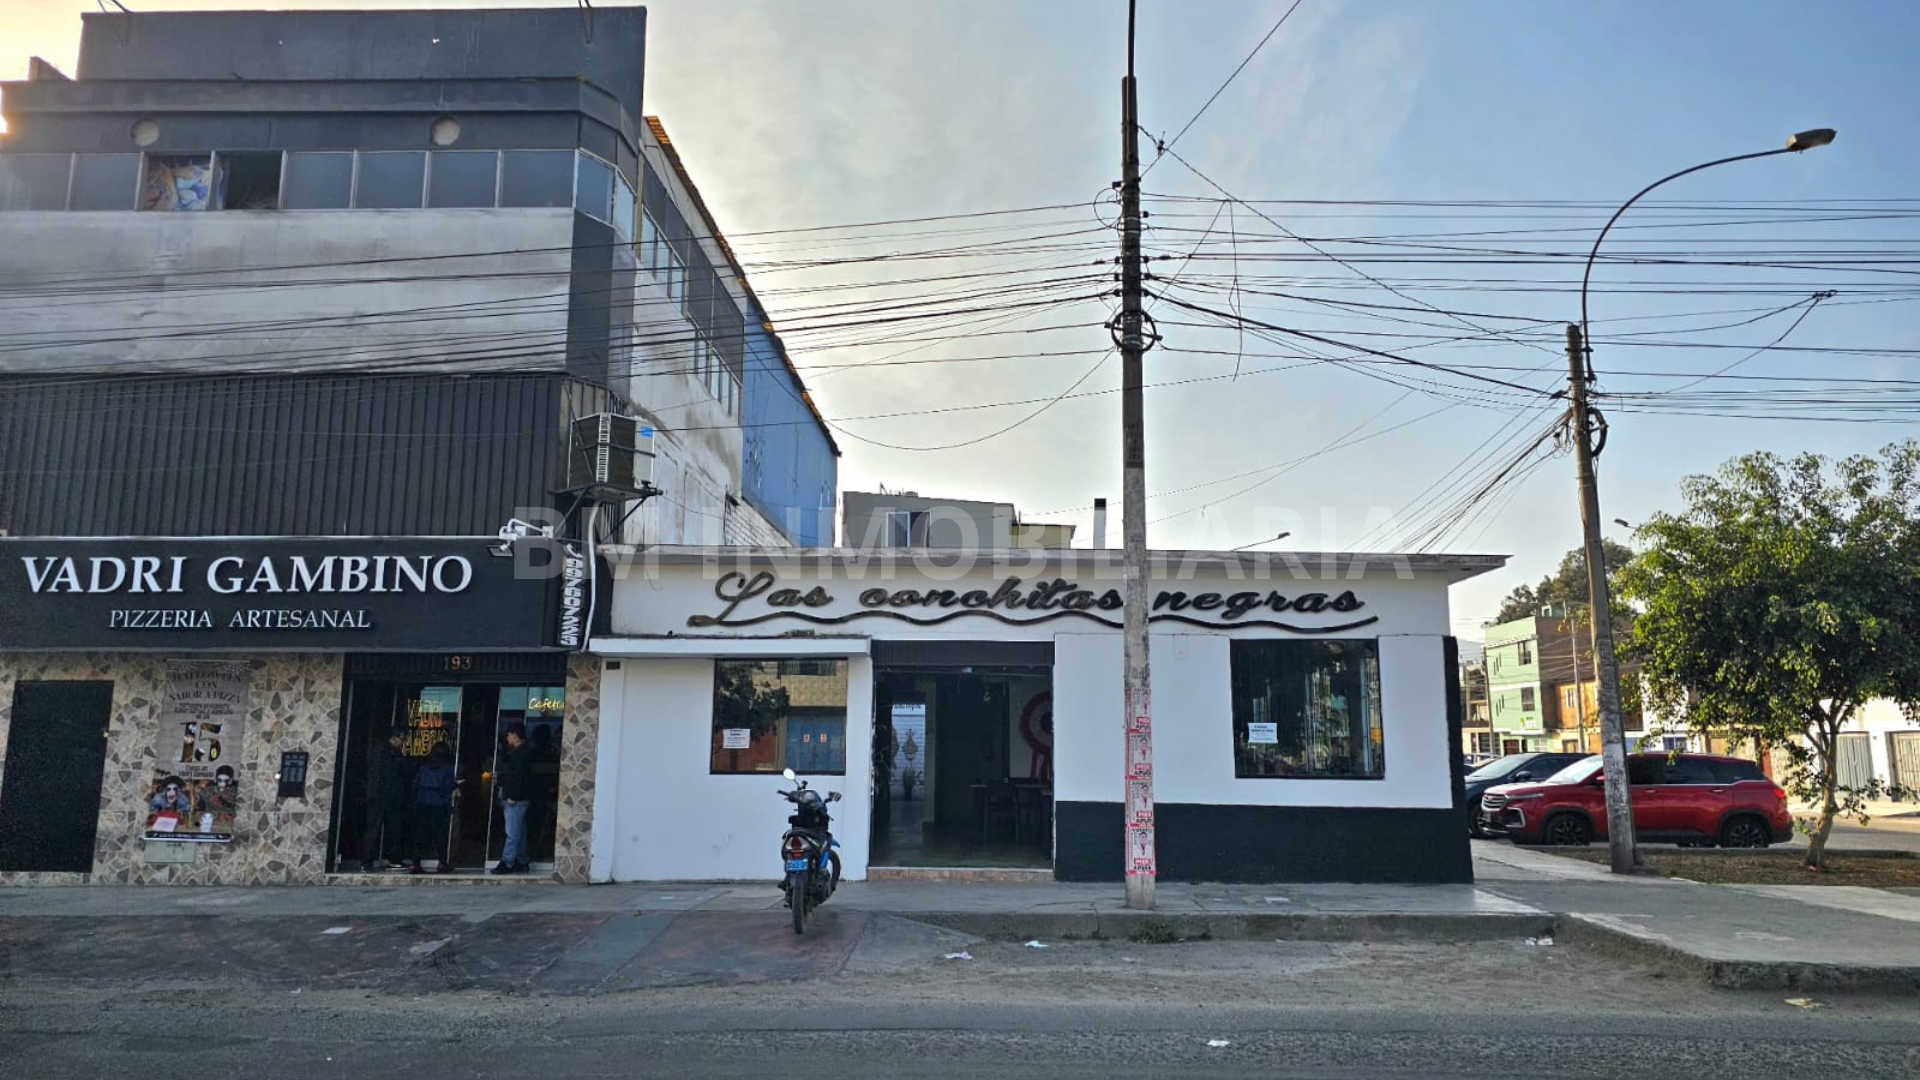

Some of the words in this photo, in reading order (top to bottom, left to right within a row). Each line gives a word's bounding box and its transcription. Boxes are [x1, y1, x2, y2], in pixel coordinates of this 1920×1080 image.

[20, 556, 188, 593] VADRI
[206, 555, 473, 594] GAMBINO
[108, 609, 213, 629] PIZZERIA
[229, 609, 371, 629] ARTESANAL
[687, 571, 835, 628] Las
[859, 576, 1124, 610] conchitas
[1152, 589, 1365, 620] negras
[444, 655, 471, 670] 193
[179, 721, 222, 763] 15
